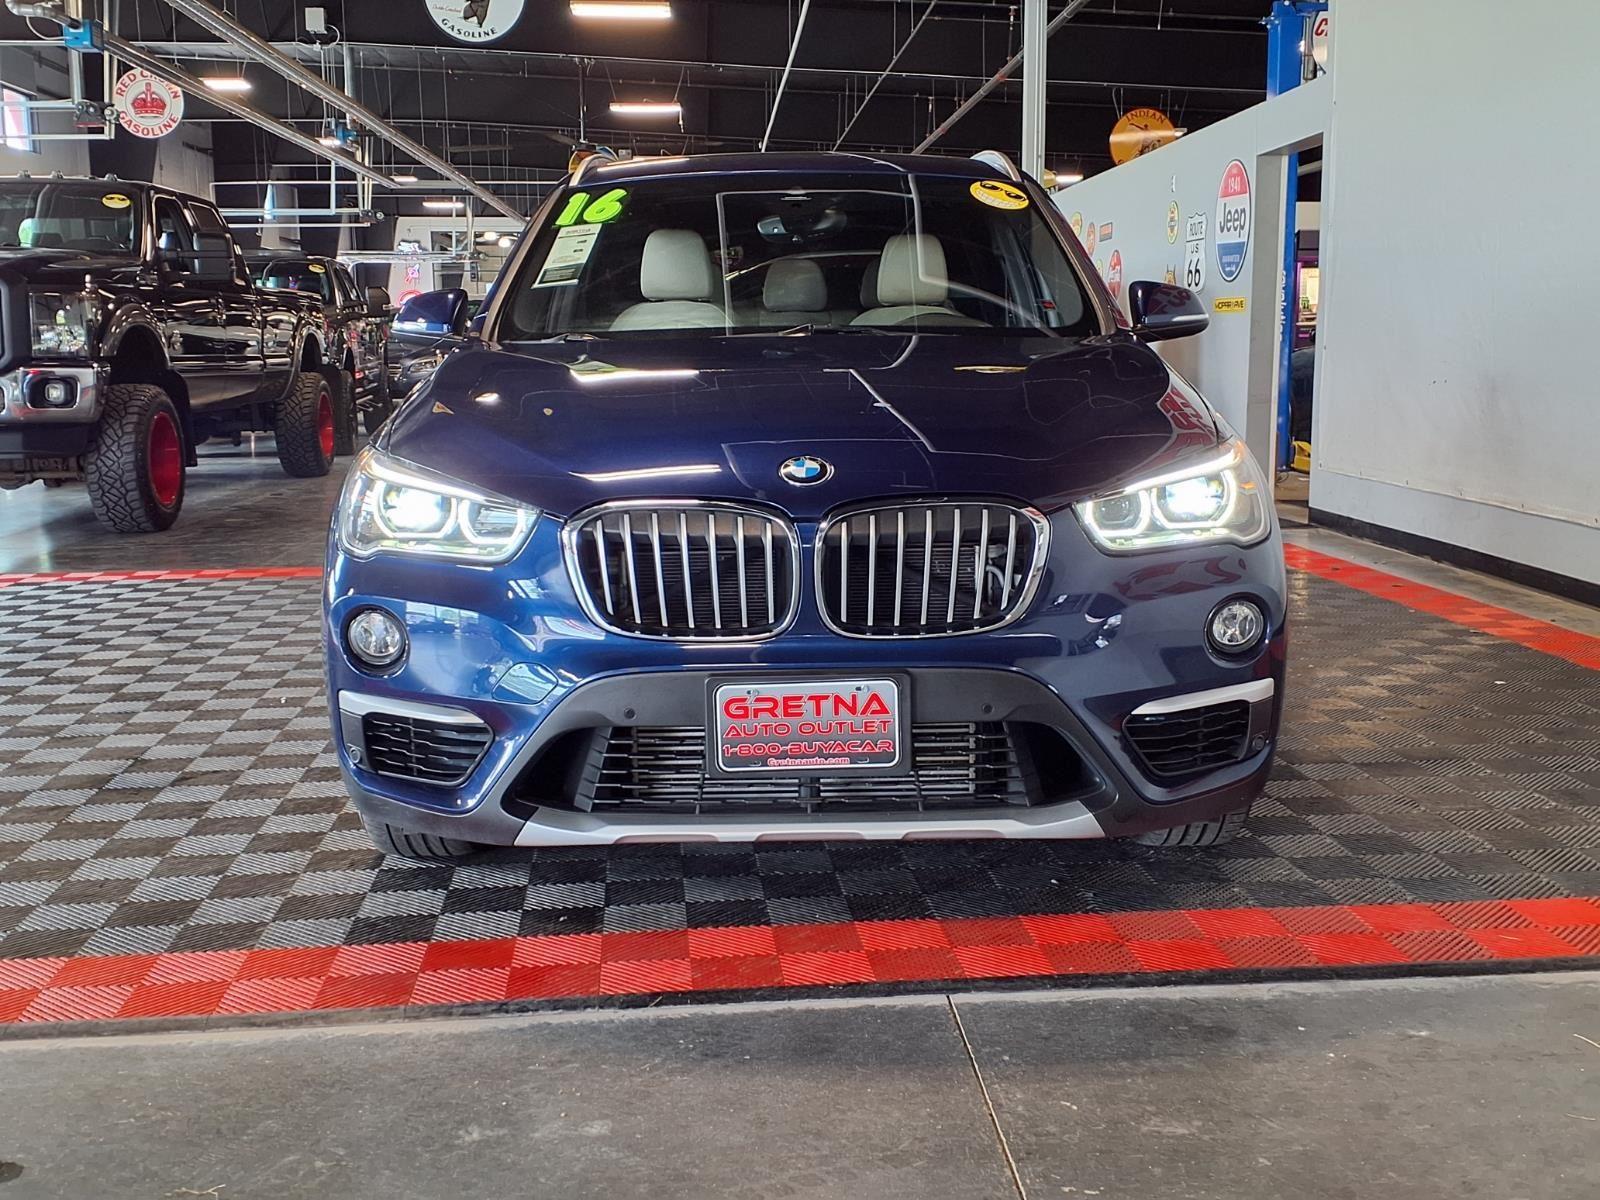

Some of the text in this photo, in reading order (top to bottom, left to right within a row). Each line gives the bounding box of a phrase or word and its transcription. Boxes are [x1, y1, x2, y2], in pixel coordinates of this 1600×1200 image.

[441, 18, 498, 38] GASOLINE
[116, 72, 137, 97] RED
[119, 110, 179, 136] GASOLINE
[1126, 109, 1167, 125] INDIAN
[1228, 176, 1241, 193] 1941
[555, 188, 628, 226] 16
[1189, 220, 1203, 237] ROUTE
[1219, 202, 1247, 239] Jeep
[1190, 243, 1199, 254] US
[1186, 258, 1201, 288] 66
[723, 692, 891, 719] GRETNA
[723, 720, 894, 738] AUTO OUTLET
[723, 740, 894, 756] 1-800-BUYACAR
[767, 756, 850, 767] Gretnaauto.com
